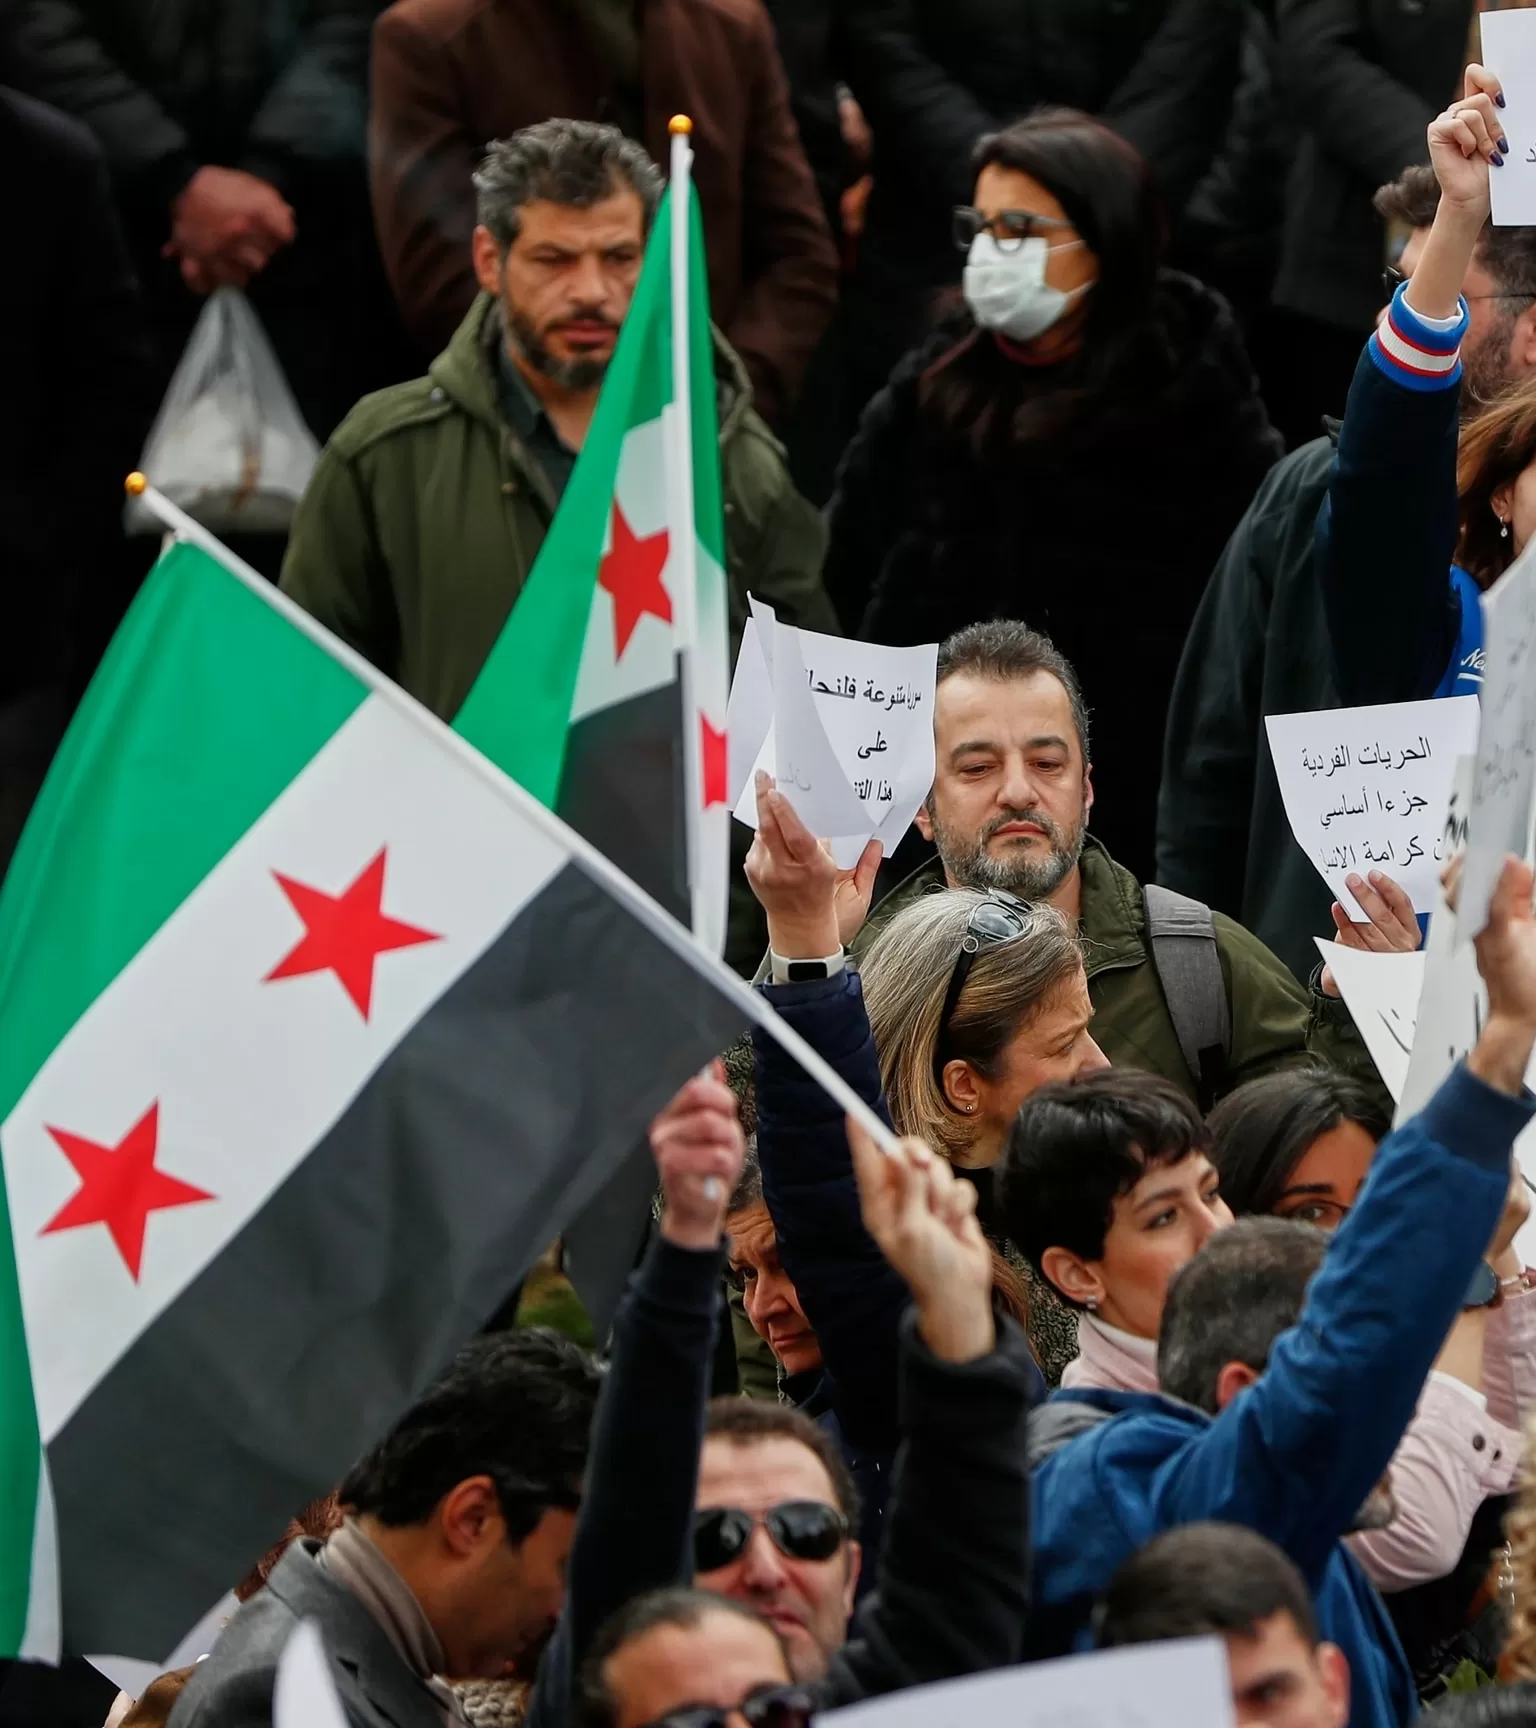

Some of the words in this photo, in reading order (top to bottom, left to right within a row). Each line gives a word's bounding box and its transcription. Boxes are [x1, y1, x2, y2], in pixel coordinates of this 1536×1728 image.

[805, 668, 857, 700] فلنحا
[856, 729, 888, 760] على
[1357, 735, 1432, 771] الحريات
[1302, 744, 1352, 778] الفردية
[1319, 786, 1370, 828] أساسي
[1376, 789, 1429, 817] جزءا
[1362, 835, 1425, 867] كرامة
